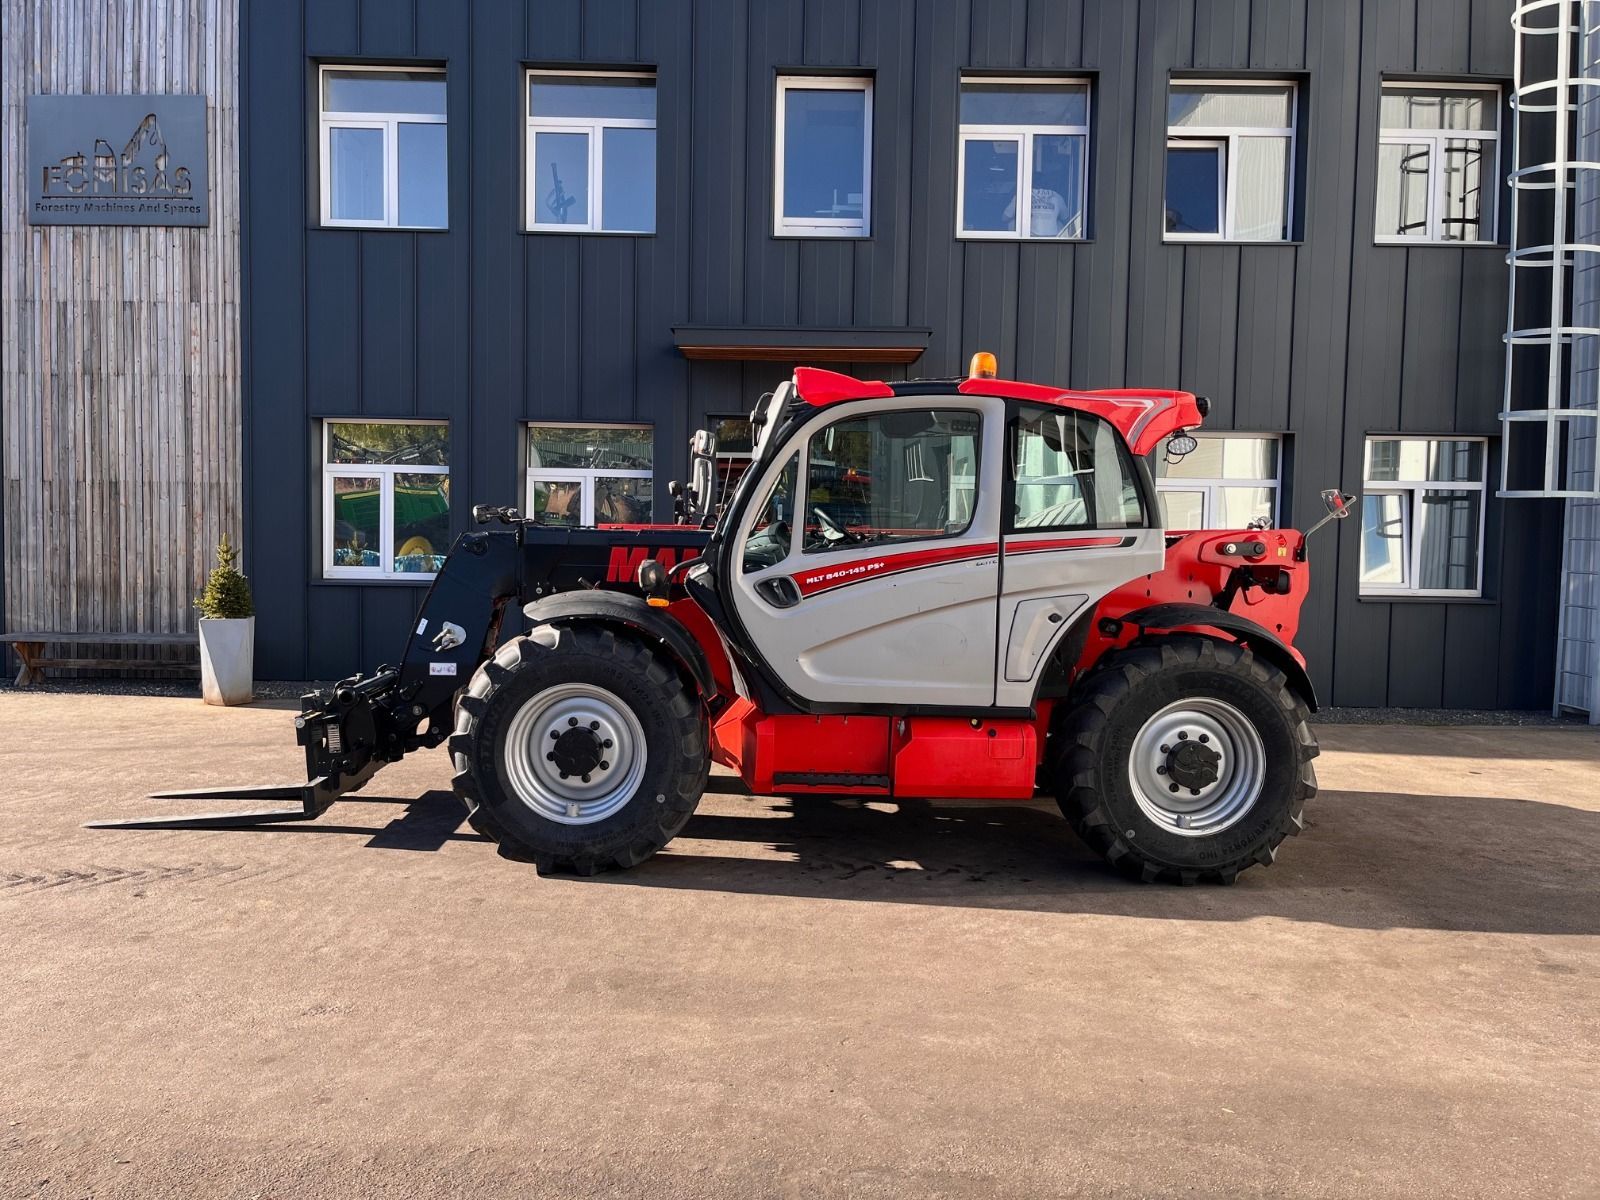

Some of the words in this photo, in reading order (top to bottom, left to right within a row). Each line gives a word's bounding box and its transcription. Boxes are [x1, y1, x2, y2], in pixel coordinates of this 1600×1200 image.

[35, 202, 80, 214] Forestry
[83, 202, 135, 213] Machines
[138, 203, 160, 213] And
[164, 204, 201, 216] Spares
[806, 574, 825, 585] MLT
[825, 566, 866, 579] 840-145
